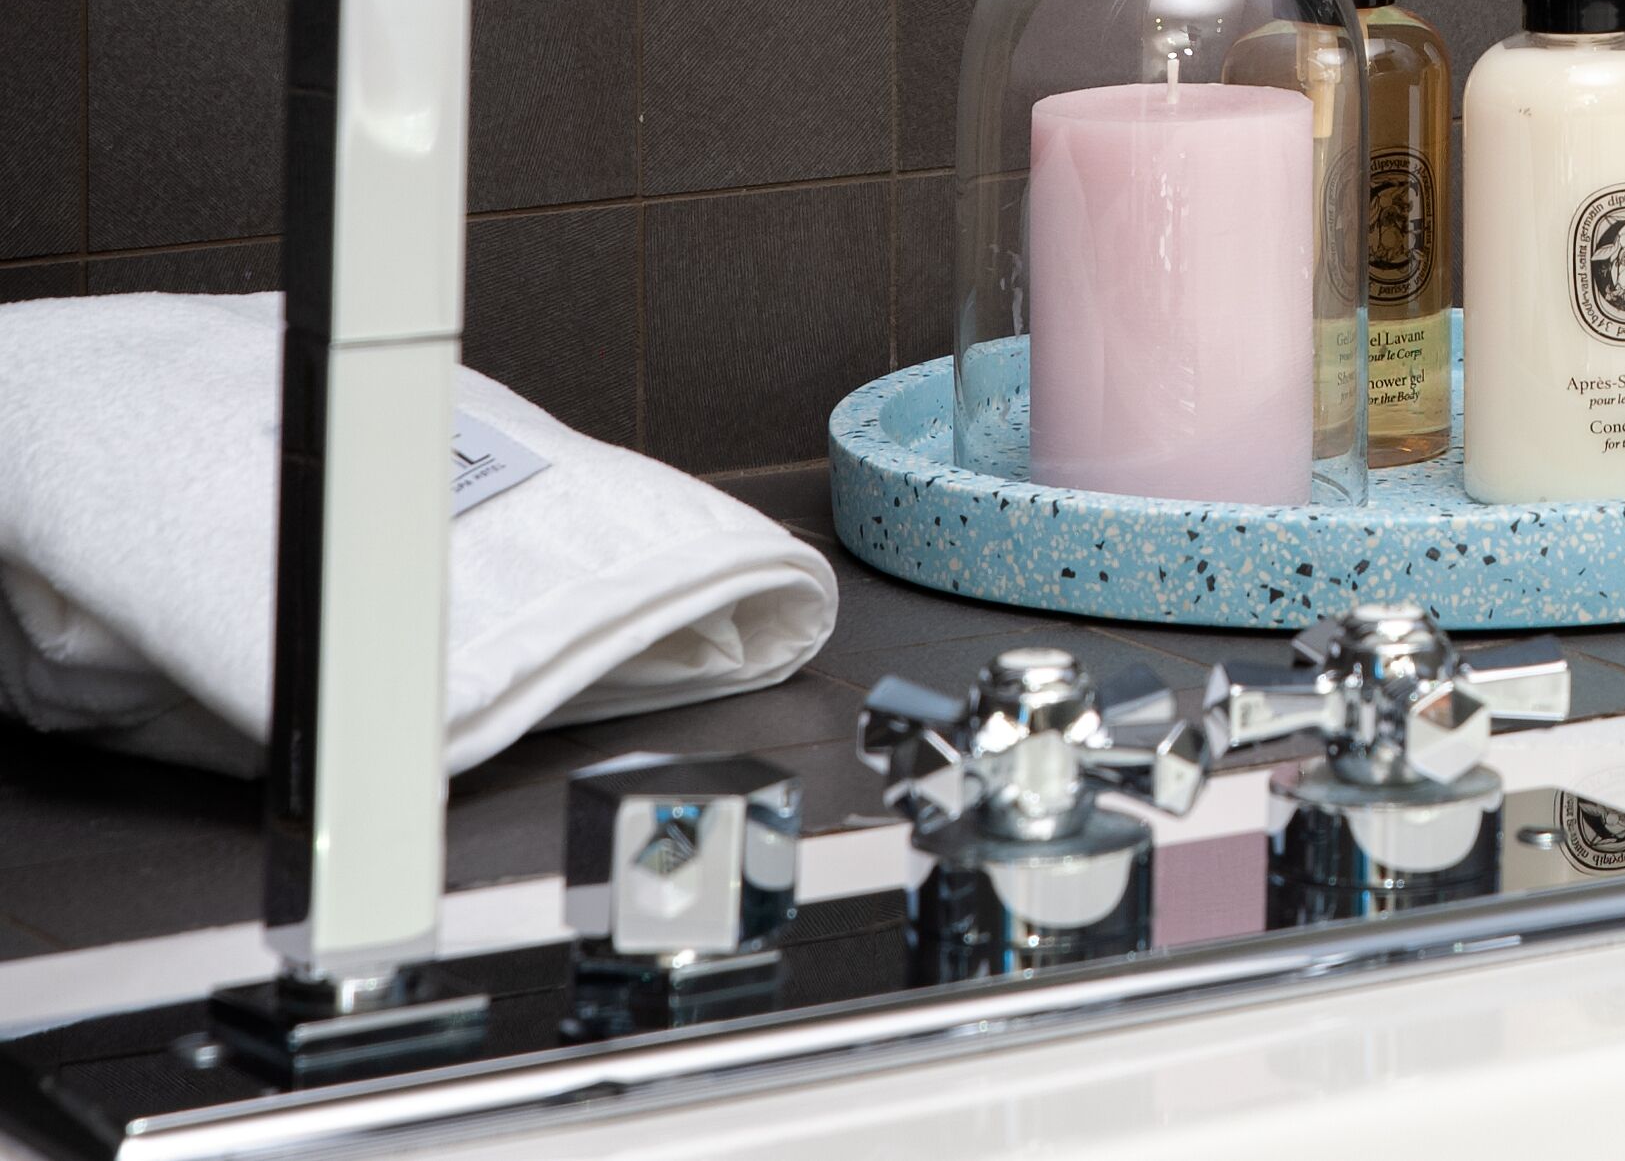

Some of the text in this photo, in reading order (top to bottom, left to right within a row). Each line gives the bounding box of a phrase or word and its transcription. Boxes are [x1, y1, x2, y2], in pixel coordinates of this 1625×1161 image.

[1369, 330, 1425, 347] el Lavant
[1368, 347, 1423, 363] our le Corps
[1368, 368, 1425, 390] ower gel
[1368, 396, 1380, 406] or
[1381, 393, 1396, 405] the
[1588, 396, 1616, 410] pour
[1602, 438, 1621, 454] for
